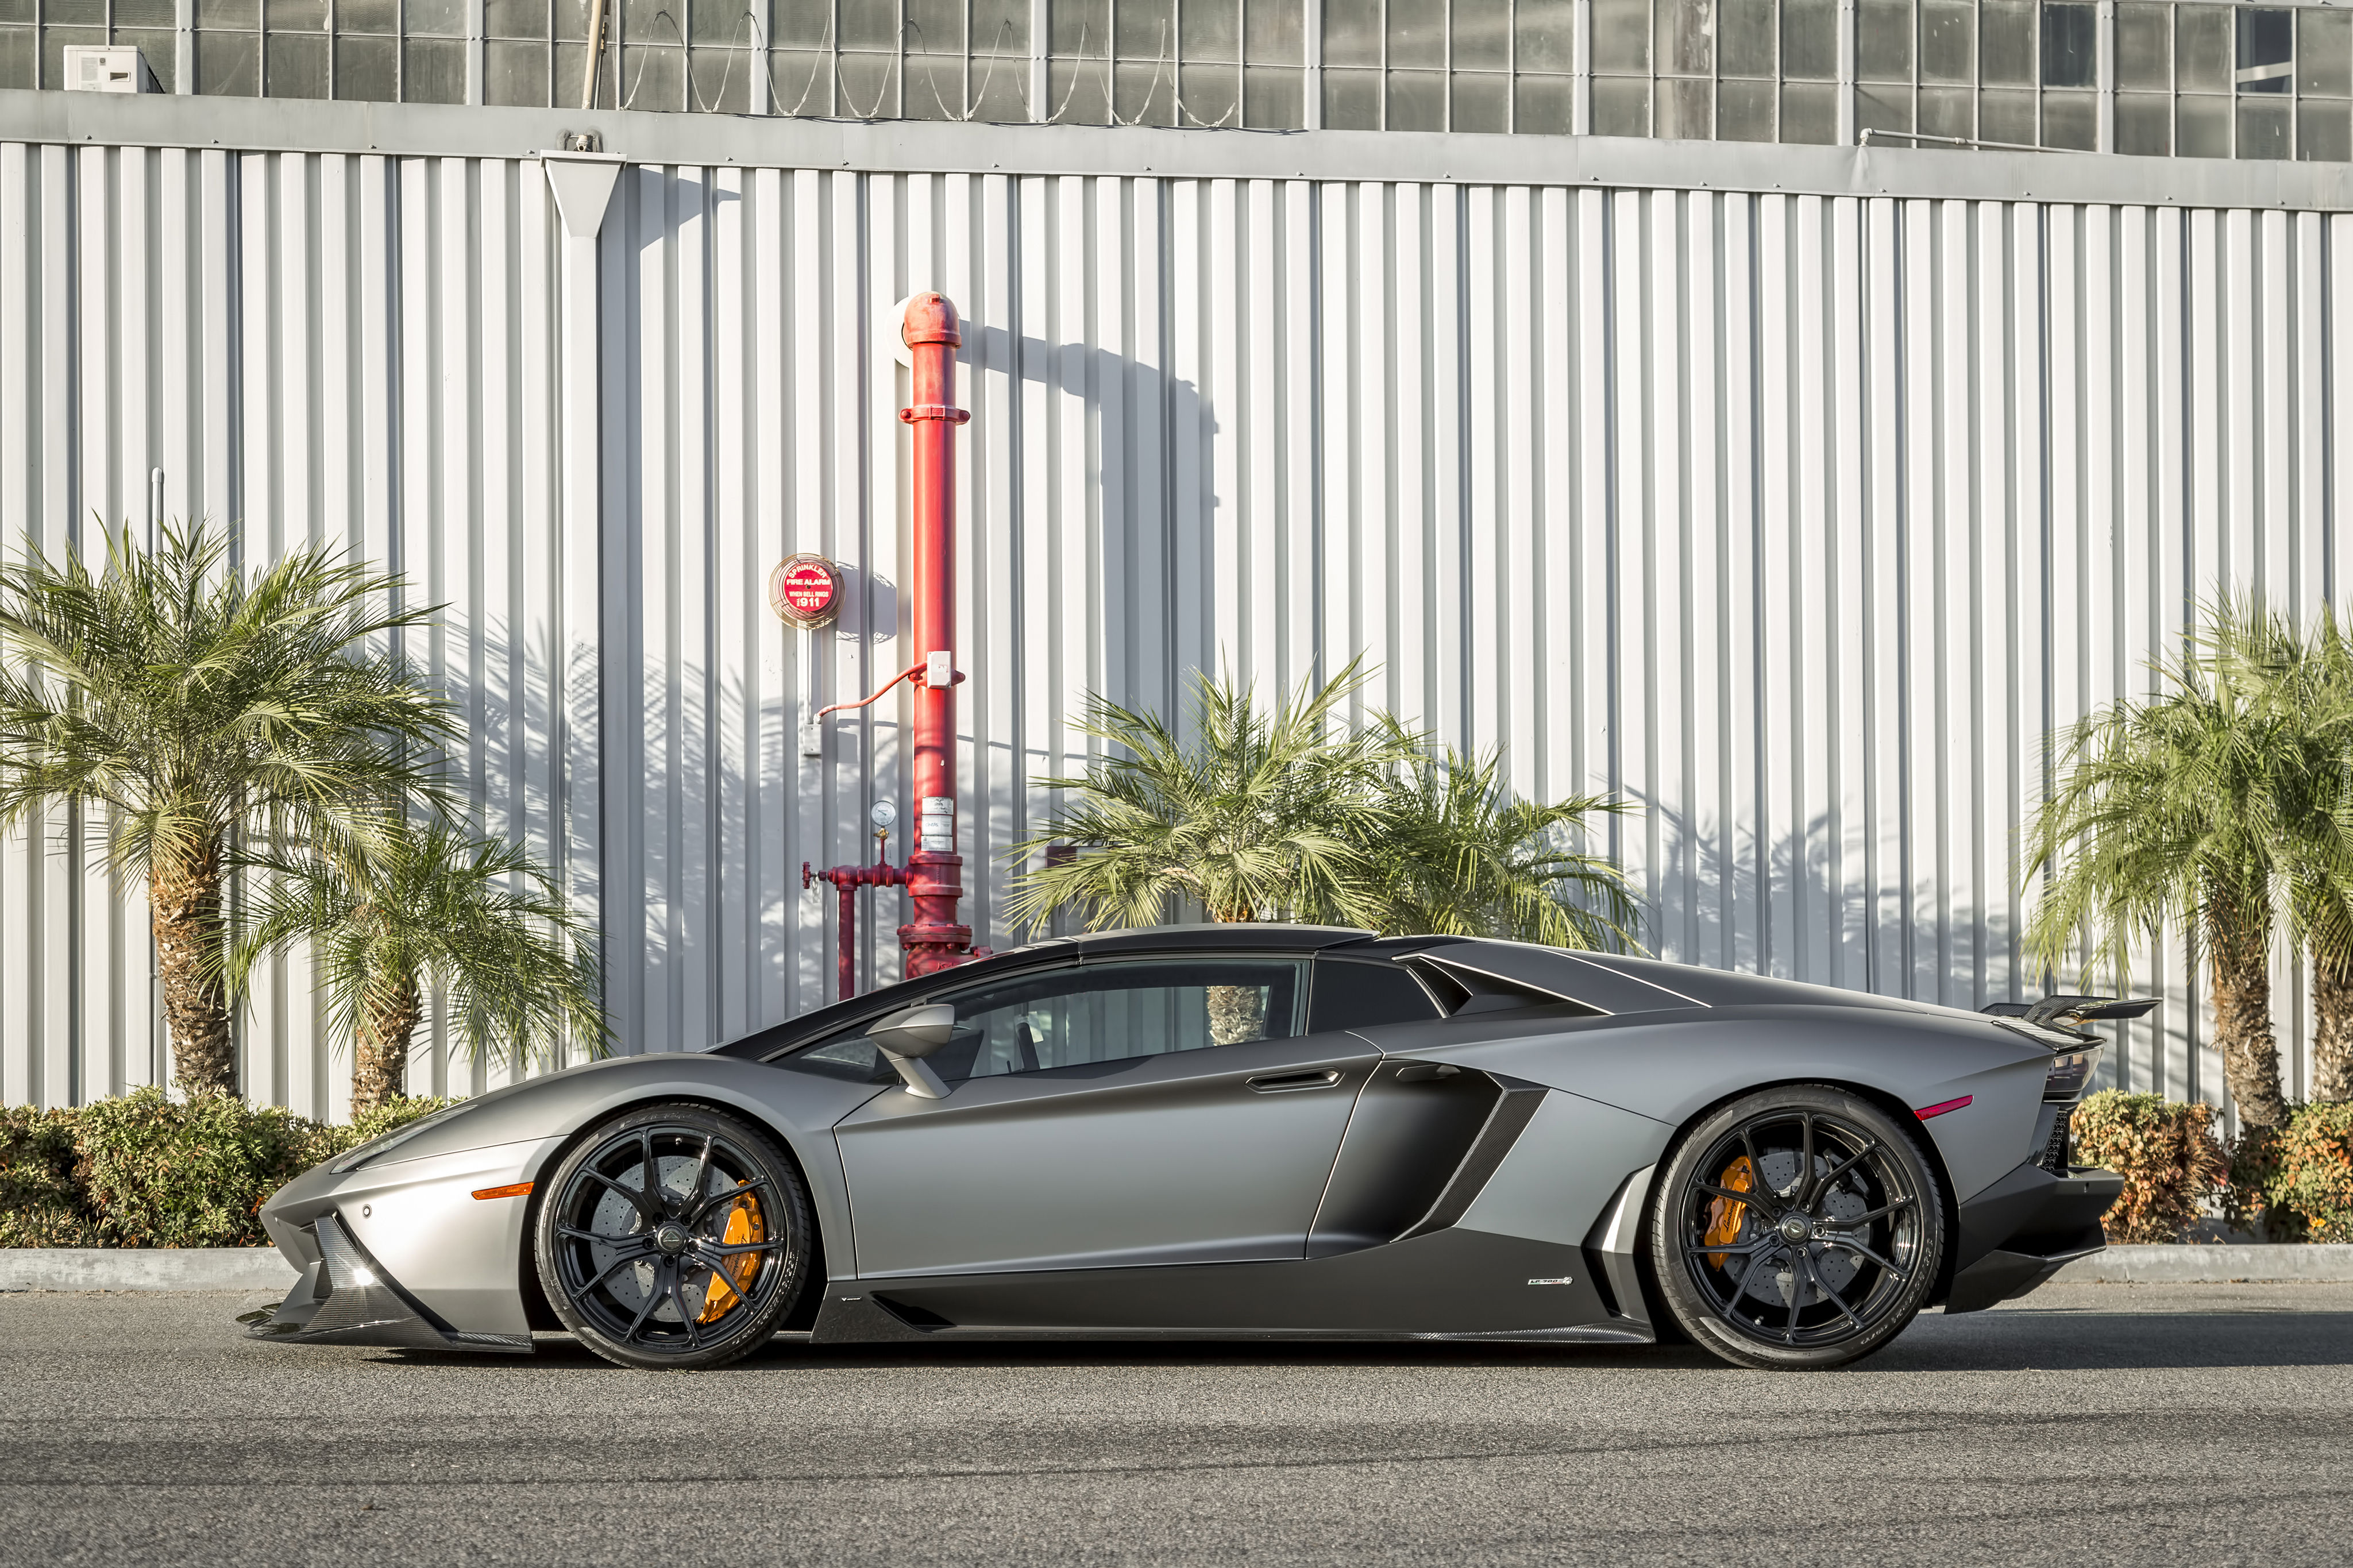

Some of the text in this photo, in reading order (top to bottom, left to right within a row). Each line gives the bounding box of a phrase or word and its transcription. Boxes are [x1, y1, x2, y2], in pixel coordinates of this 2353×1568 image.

[788, 564, 827, 578] SPRINKLER
[800, 597, 819, 607] 911
[1752, 1351, 1787, 1362] OUTSIDE
